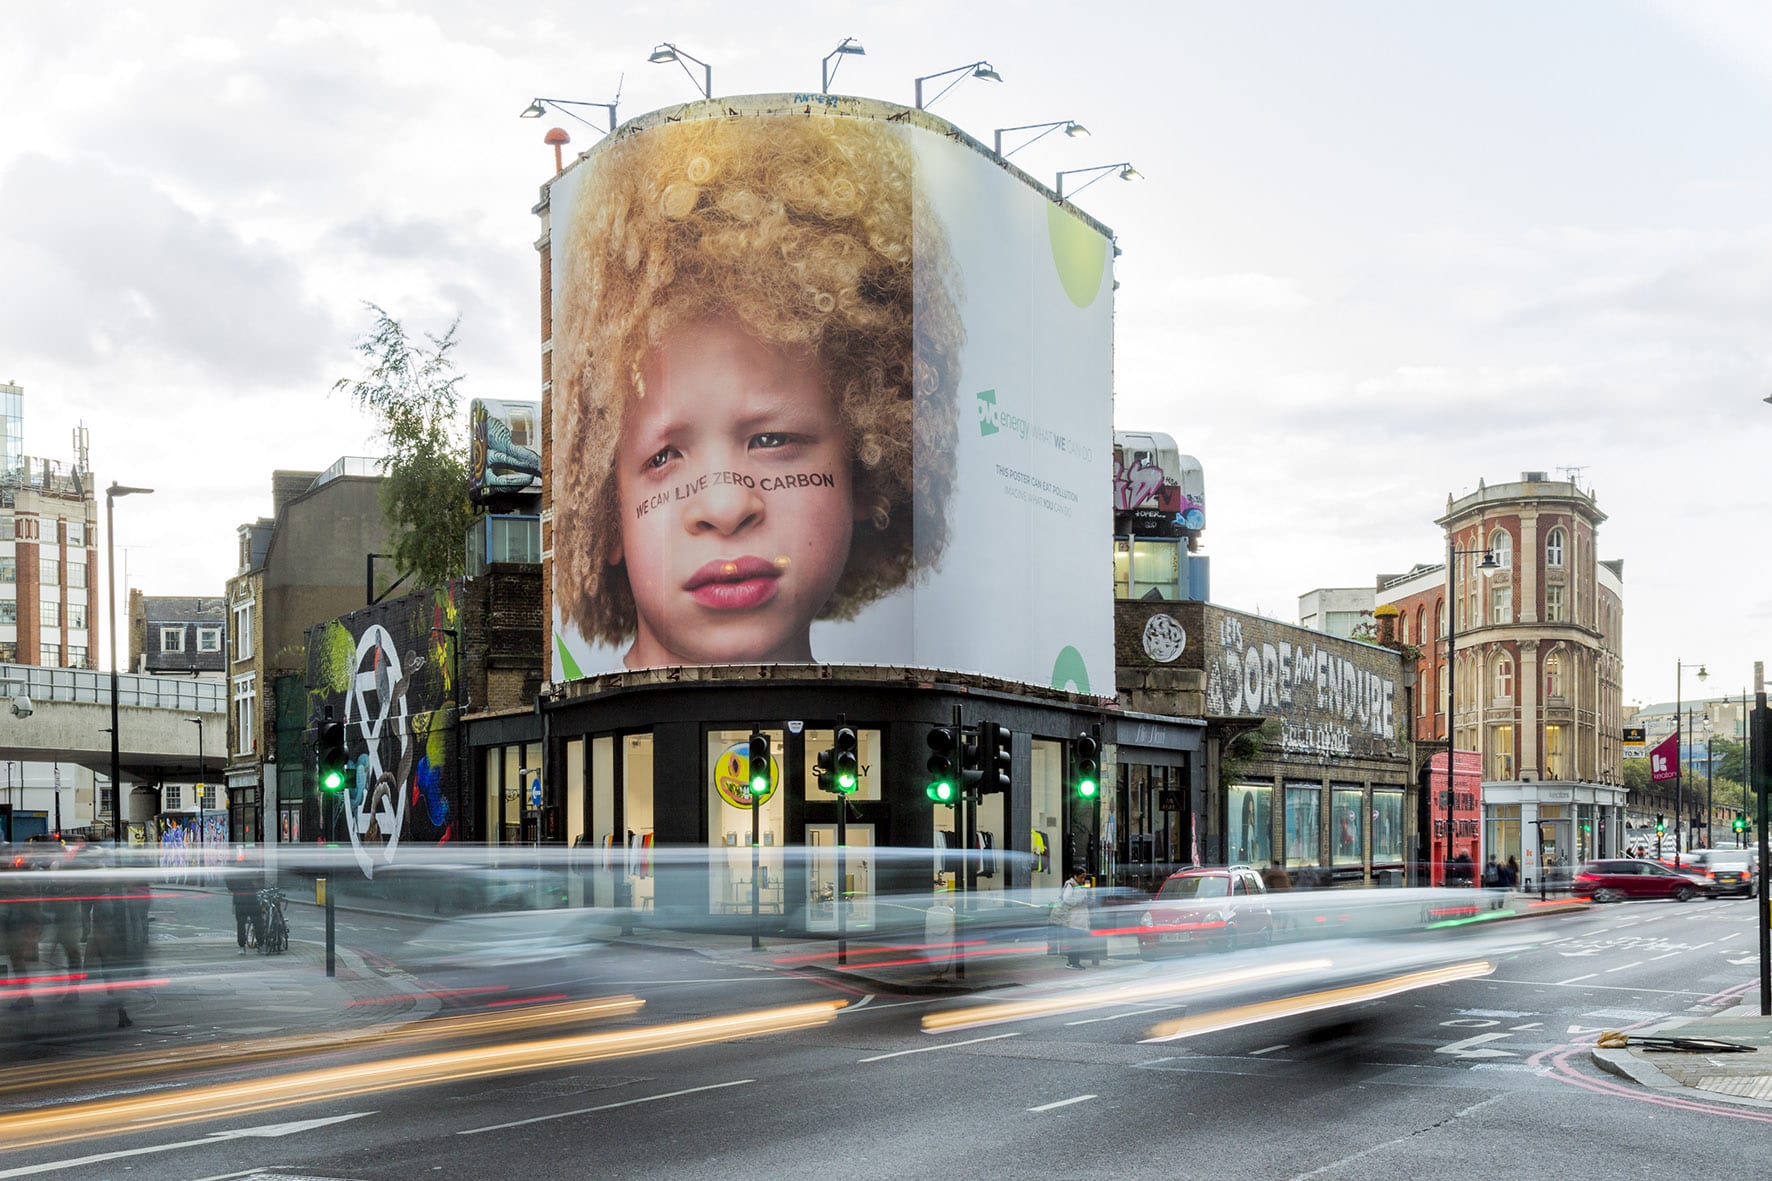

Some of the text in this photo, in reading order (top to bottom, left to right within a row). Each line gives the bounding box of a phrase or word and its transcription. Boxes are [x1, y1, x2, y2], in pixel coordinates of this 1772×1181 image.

[1000, 411, 1030, 440] energy
[1053, 433, 1066, 452] WE
[636, 471, 835, 520] WE CAN LIVE ZERO CARBON
[996, 463, 1079, 503] THIS POSTER CAN EAT POLLUTION
[1206, 640, 1293, 717] ADORE
[1317, 650, 1395, 740] ENDURE
[1654, 771, 1678, 780] keaton
